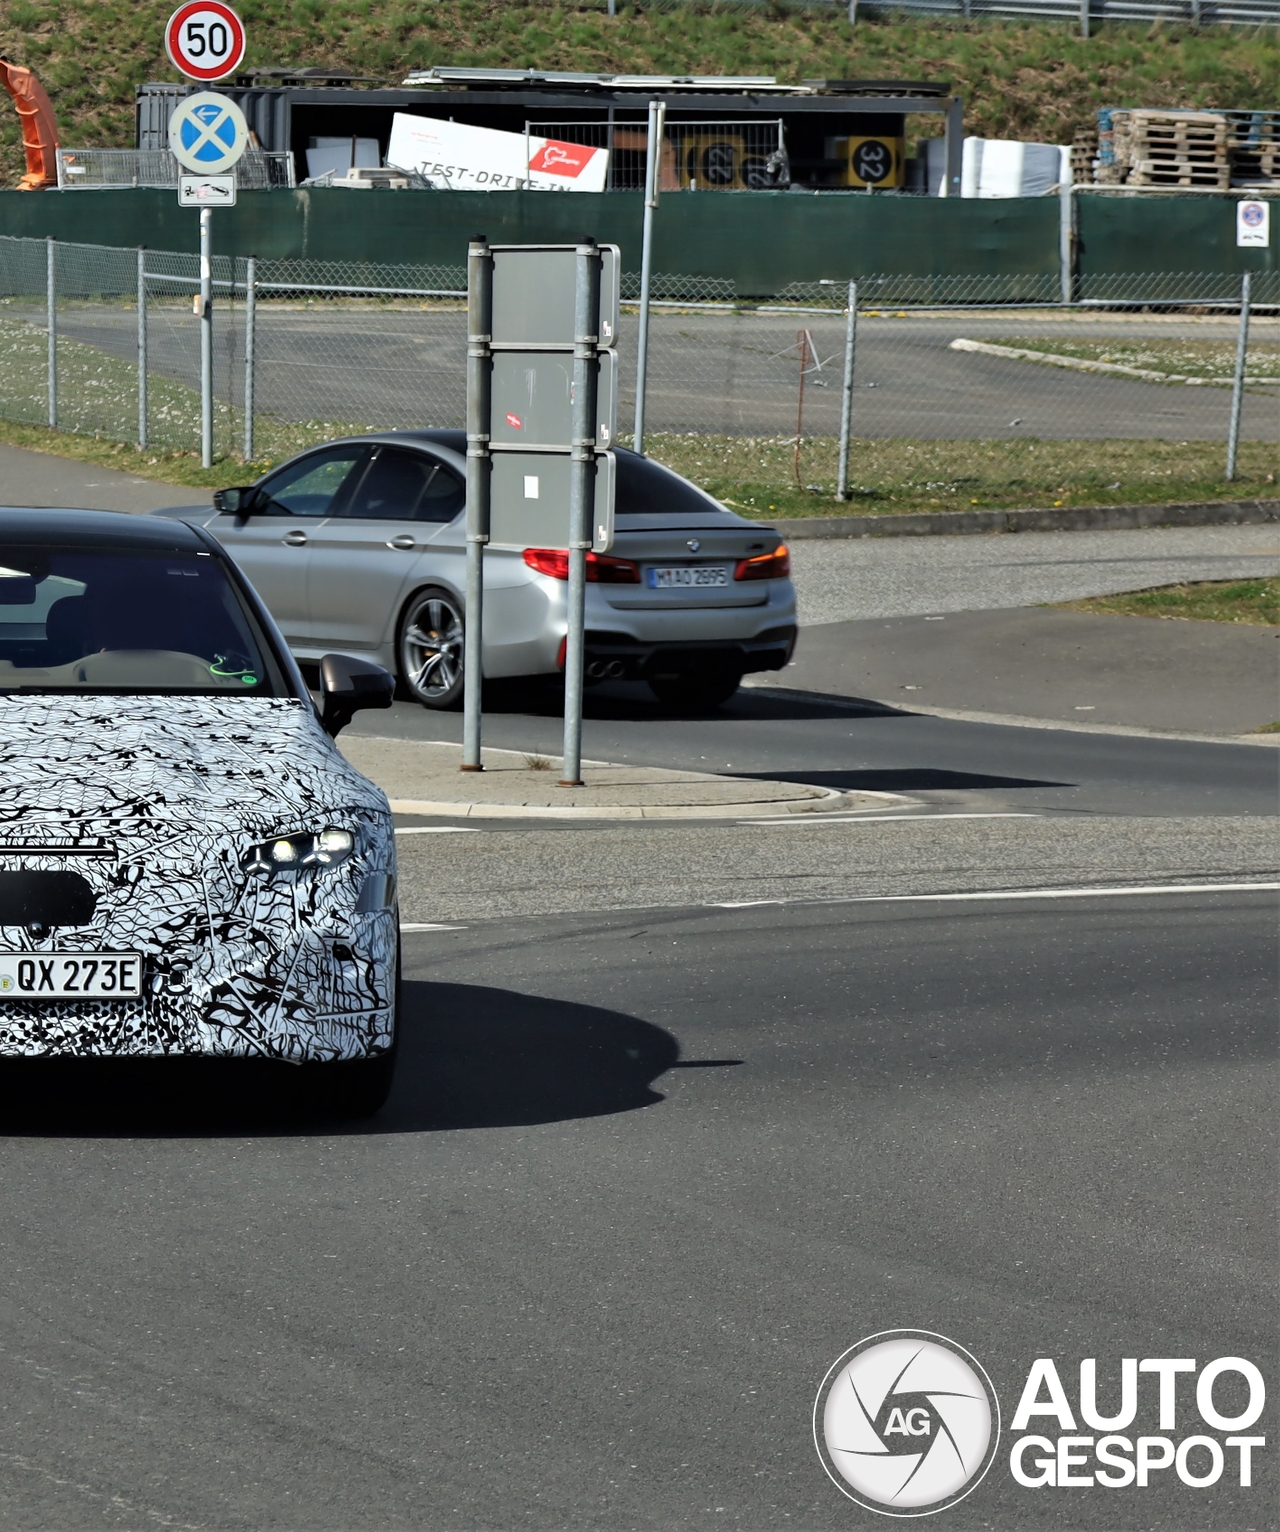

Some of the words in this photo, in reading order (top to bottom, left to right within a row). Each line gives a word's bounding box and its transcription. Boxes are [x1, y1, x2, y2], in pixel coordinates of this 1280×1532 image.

[187, 22, 228, 57] 50
[860, 146, 884, 177] 32
[17, 959, 55, 991] QX
[63, 959, 136, 991] 273E
